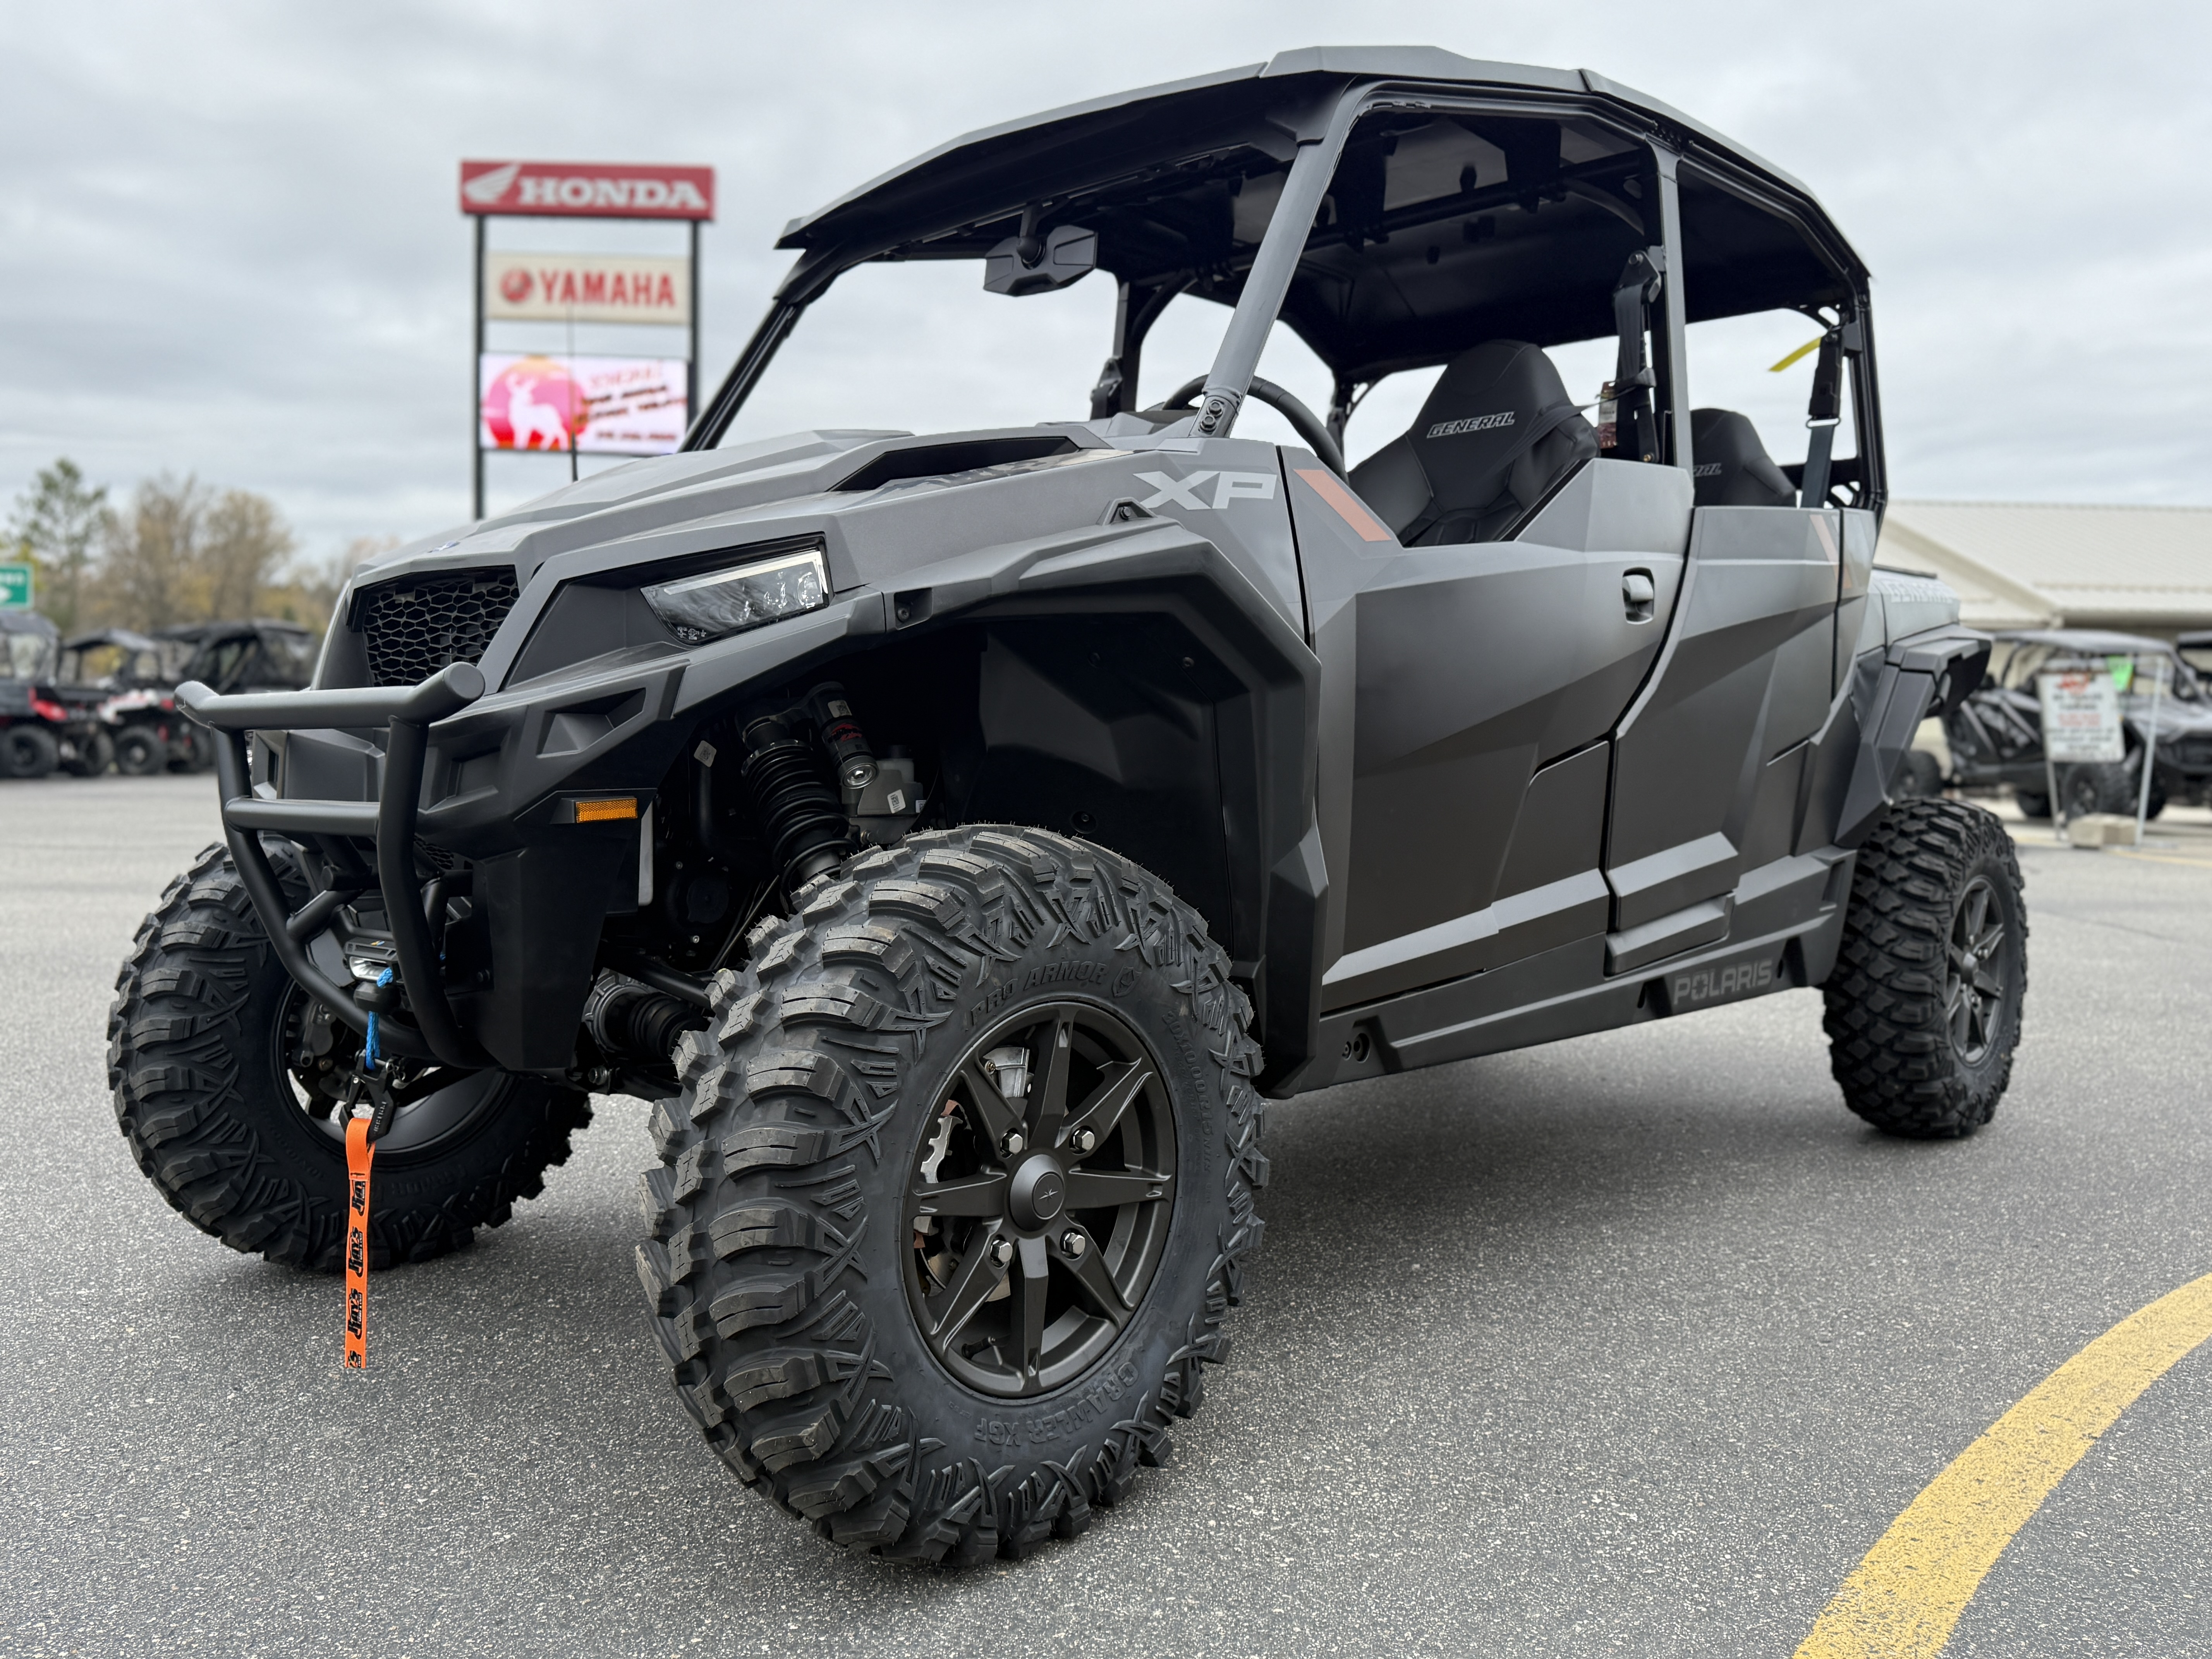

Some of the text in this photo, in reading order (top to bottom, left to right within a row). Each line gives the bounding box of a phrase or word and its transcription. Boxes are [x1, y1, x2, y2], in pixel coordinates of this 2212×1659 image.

[517, 177, 706, 210] HONDA
[540, 270, 676, 307] YAMAHA
[1427, 410, 1515, 438] GENERAL
[1133, 470, 1278, 510] XP
[970, 960, 1110, 1025] PRO ARMOR
[1673, 959, 1772, 1005] POLARIS
[1029, 1361, 1139, 1444] CRAWLER
[974, 1418, 1022, 1447] XGF
